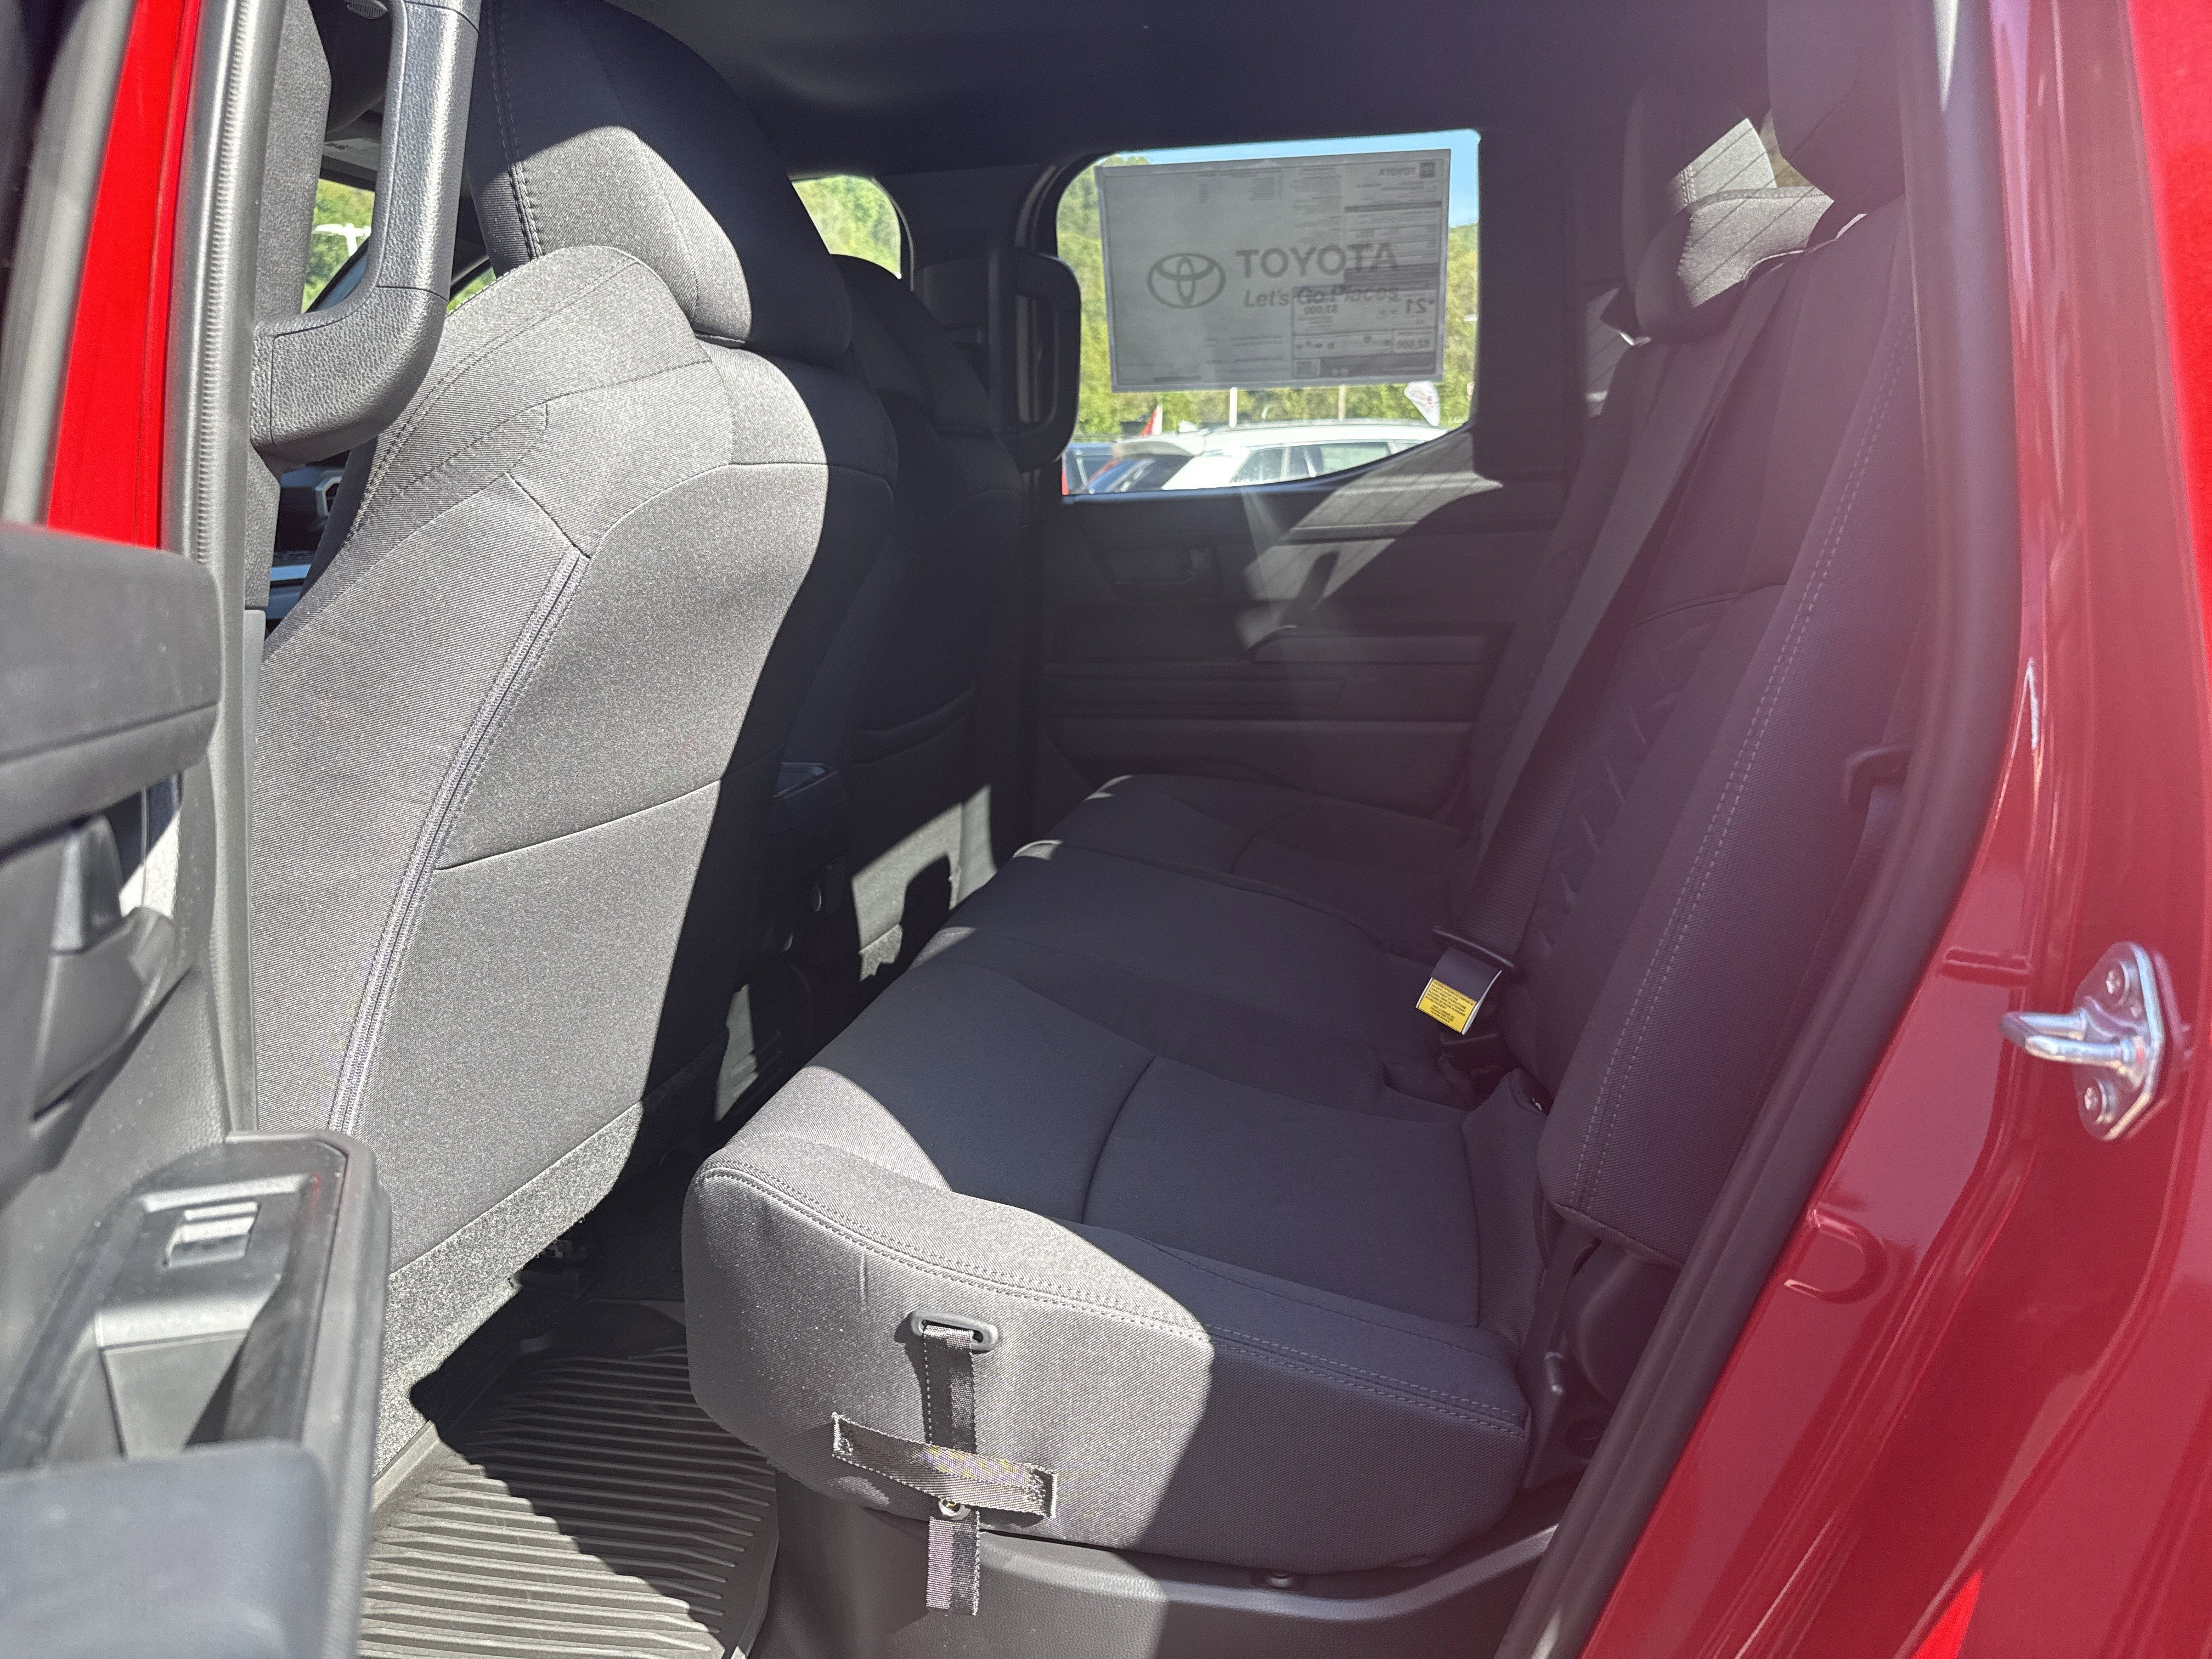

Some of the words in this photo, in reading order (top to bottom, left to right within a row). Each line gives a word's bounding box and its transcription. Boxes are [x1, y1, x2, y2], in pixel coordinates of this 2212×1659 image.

[1236, 242, 1397, 279] TOYOTA
[1244, 289, 1289, 308] Let's
[1295, 285, 1326, 303] Go
